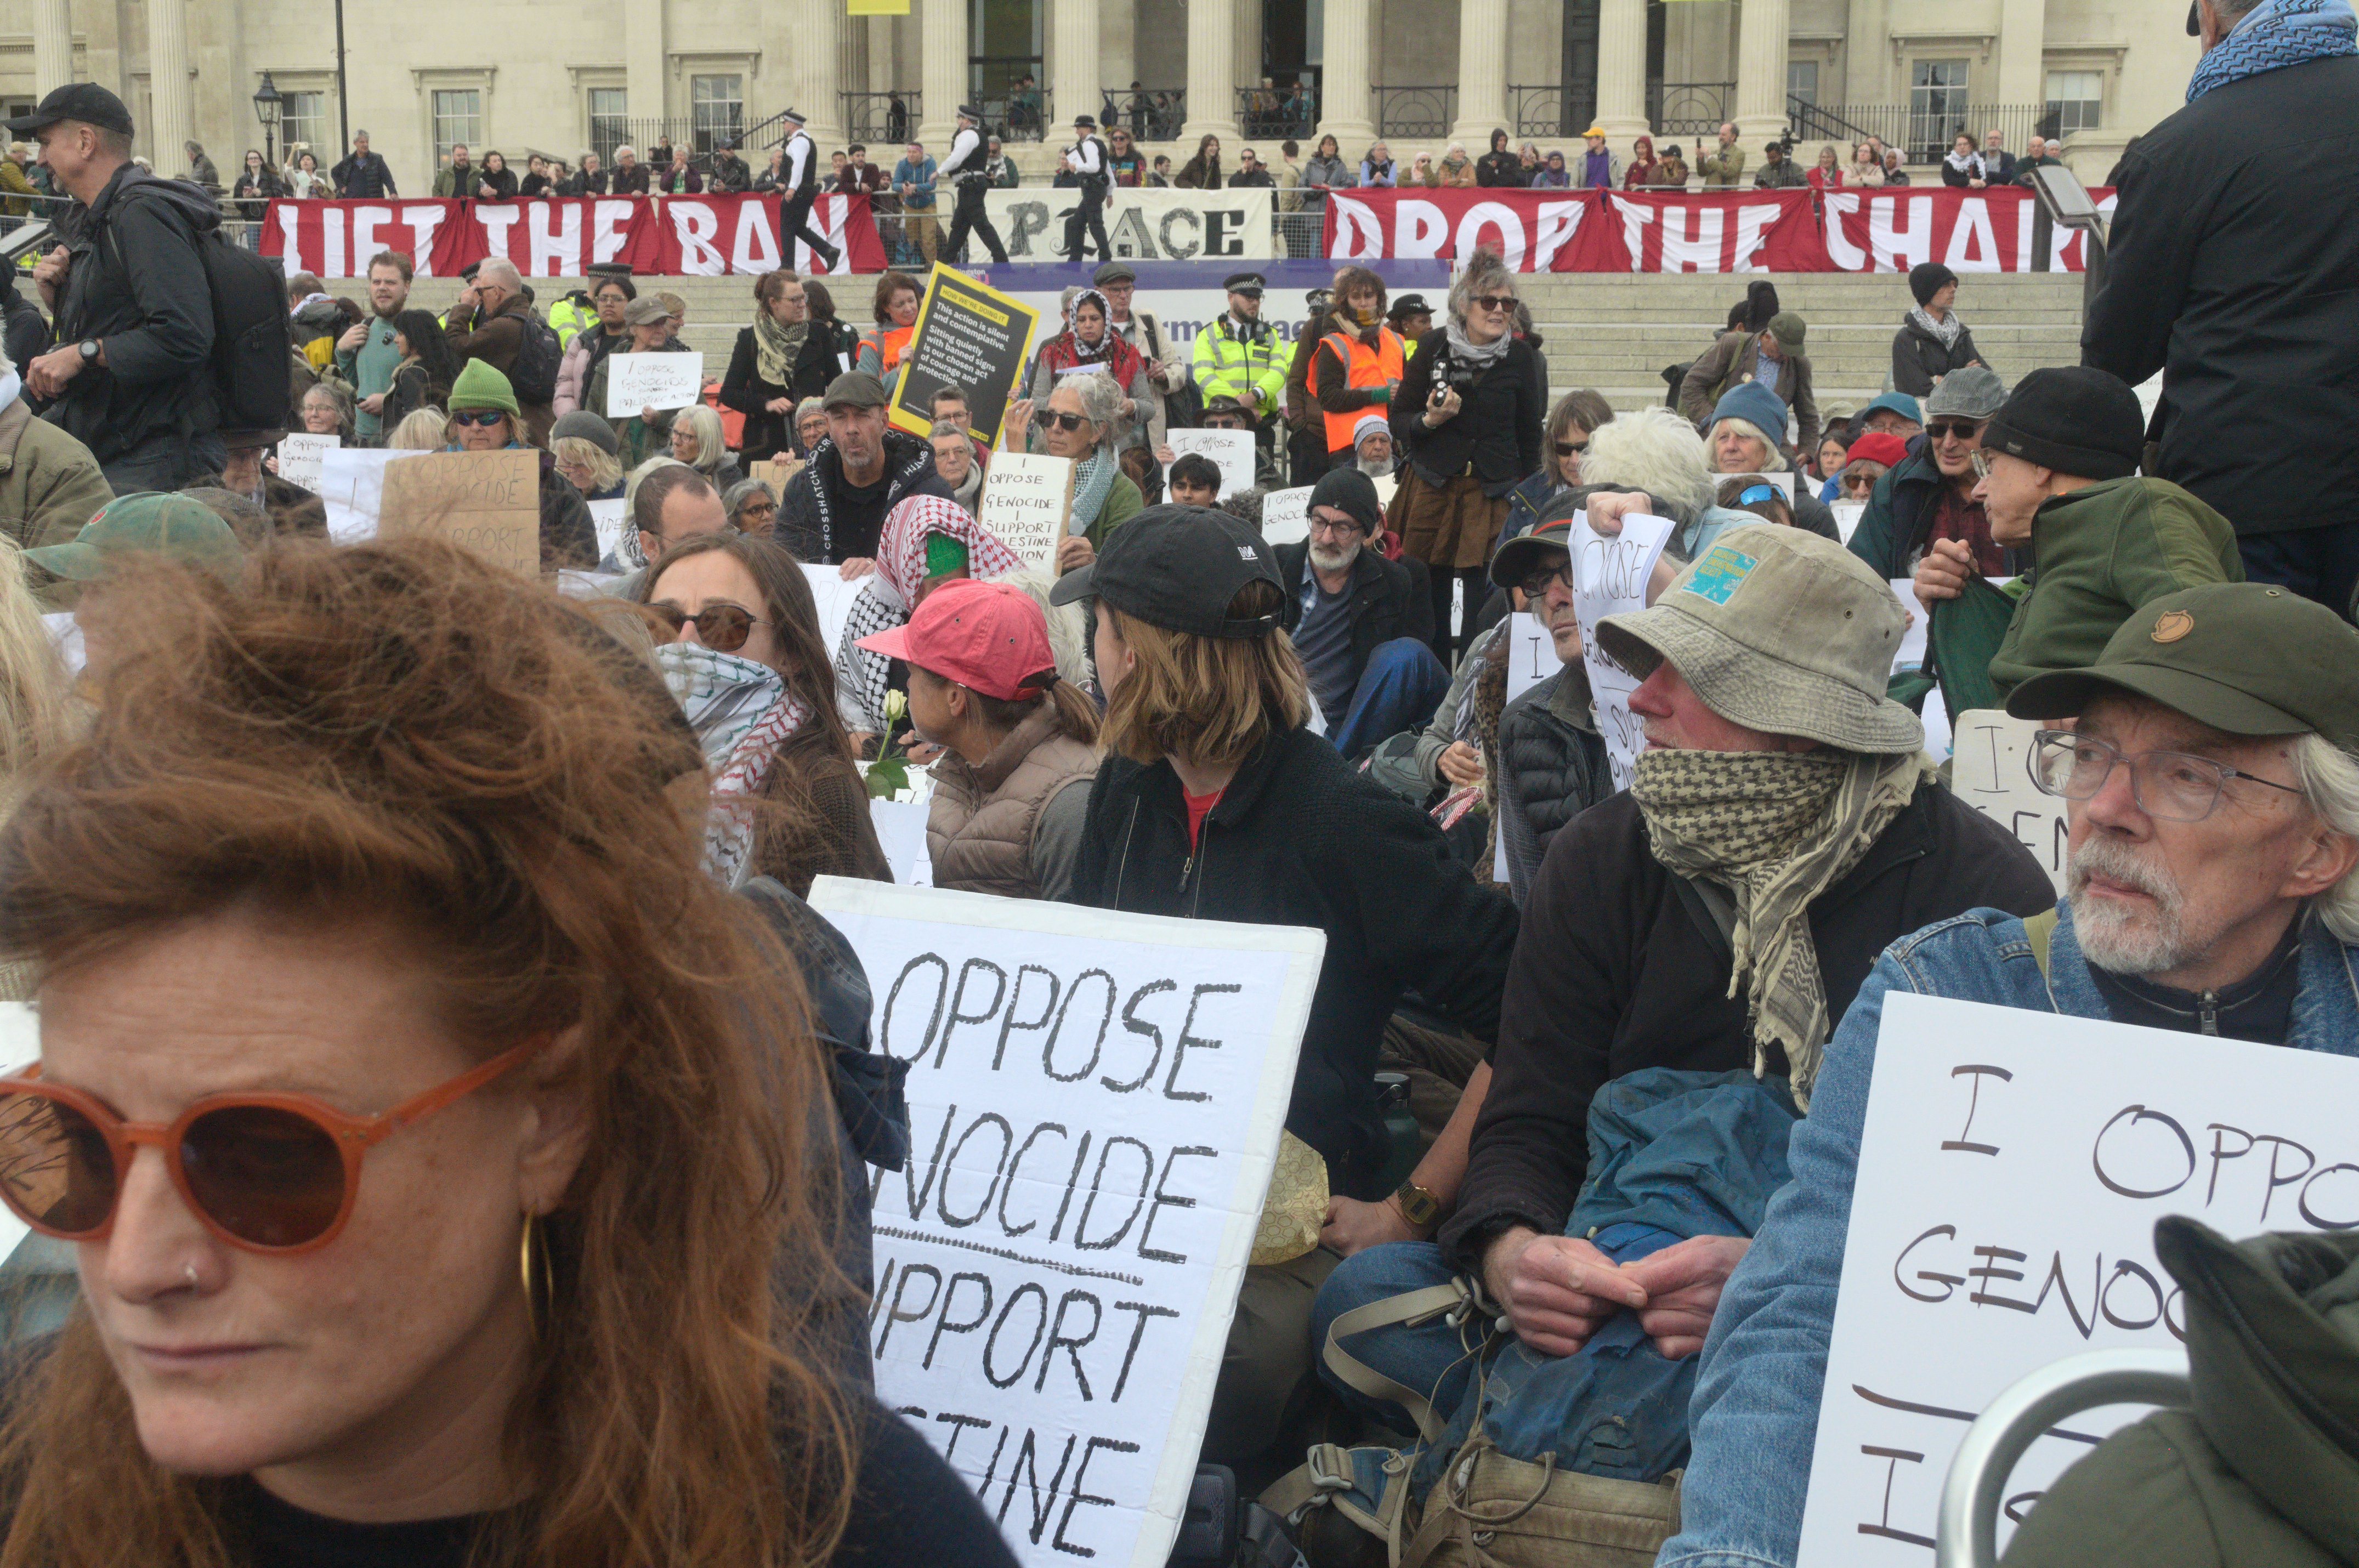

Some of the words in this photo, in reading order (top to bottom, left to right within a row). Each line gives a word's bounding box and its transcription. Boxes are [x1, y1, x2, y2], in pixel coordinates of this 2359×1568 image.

[277, 204, 446, 277] LIFT
[475, 200, 635, 277] THE
[668, 195, 852, 276] BAN
[1330, 192, 1585, 274] DROP
[1611, 194, 1781, 273] THE
[1824, 192, 2117, 273] CHAR
[942, 289, 957, 301] HOW
[979, 305, 998, 318] DOING
[933, 312, 948, 324] and
[949, 319, 1006, 351] contemplative.
[937, 302, 952, 316] This
[954, 310, 978, 327] action
[979, 321, 986, 331] is
[987, 326, 1010, 342] silent
[927, 335, 943, 348] with
[945, 343, 974, 362] banned
[975, 356, 996, 372] signs
[929, 325, 955, 344] Sitting
[956, 337, 983, 356] quietly
[921, 354, 930, 362] of
[929, 357, 961, 377] courage
[962, 372, 977, 385] and
[923, 343, 930, 353] is
[932, 348, 946, 359] our
[946, 354, 974, 373] chosen
[974, 368, 988, 379] act
[1178, 437, 1189, 453] I
[419, 455, 528, 483] OPPOSE
[989, 473, 1044, 484] OPPOSE
[1022, 458, 1026, 468] I
[418, 480, 520, 504] ENOCIDE
[986, 494, 1056, 509] GENOCIDE
[1267, 497, 1271, 508] I
[1276, 491, 1311, 504] OPPOS
[809, 470, 831, 549] CROSSHATCH
[1016, 510, 1019, 521] I
[1264, 510, 1307, 525] GENOCI
[452, 527, 528, 553] PPORT
[986, 520, 1057, 533] SUPPORT
[997, 535, 1054, 547] LESTINE
[1528, 637, 1544, 679] I
[1973, 725, 2010, 793] I
[881, 952, 1243, 1103] OPPOSE
[1941, 1064, 2014, 1157] I
[2094, 1104, 2359, 1230] OPPO
[871, 1102, 1218, 1264] NOCIDE
